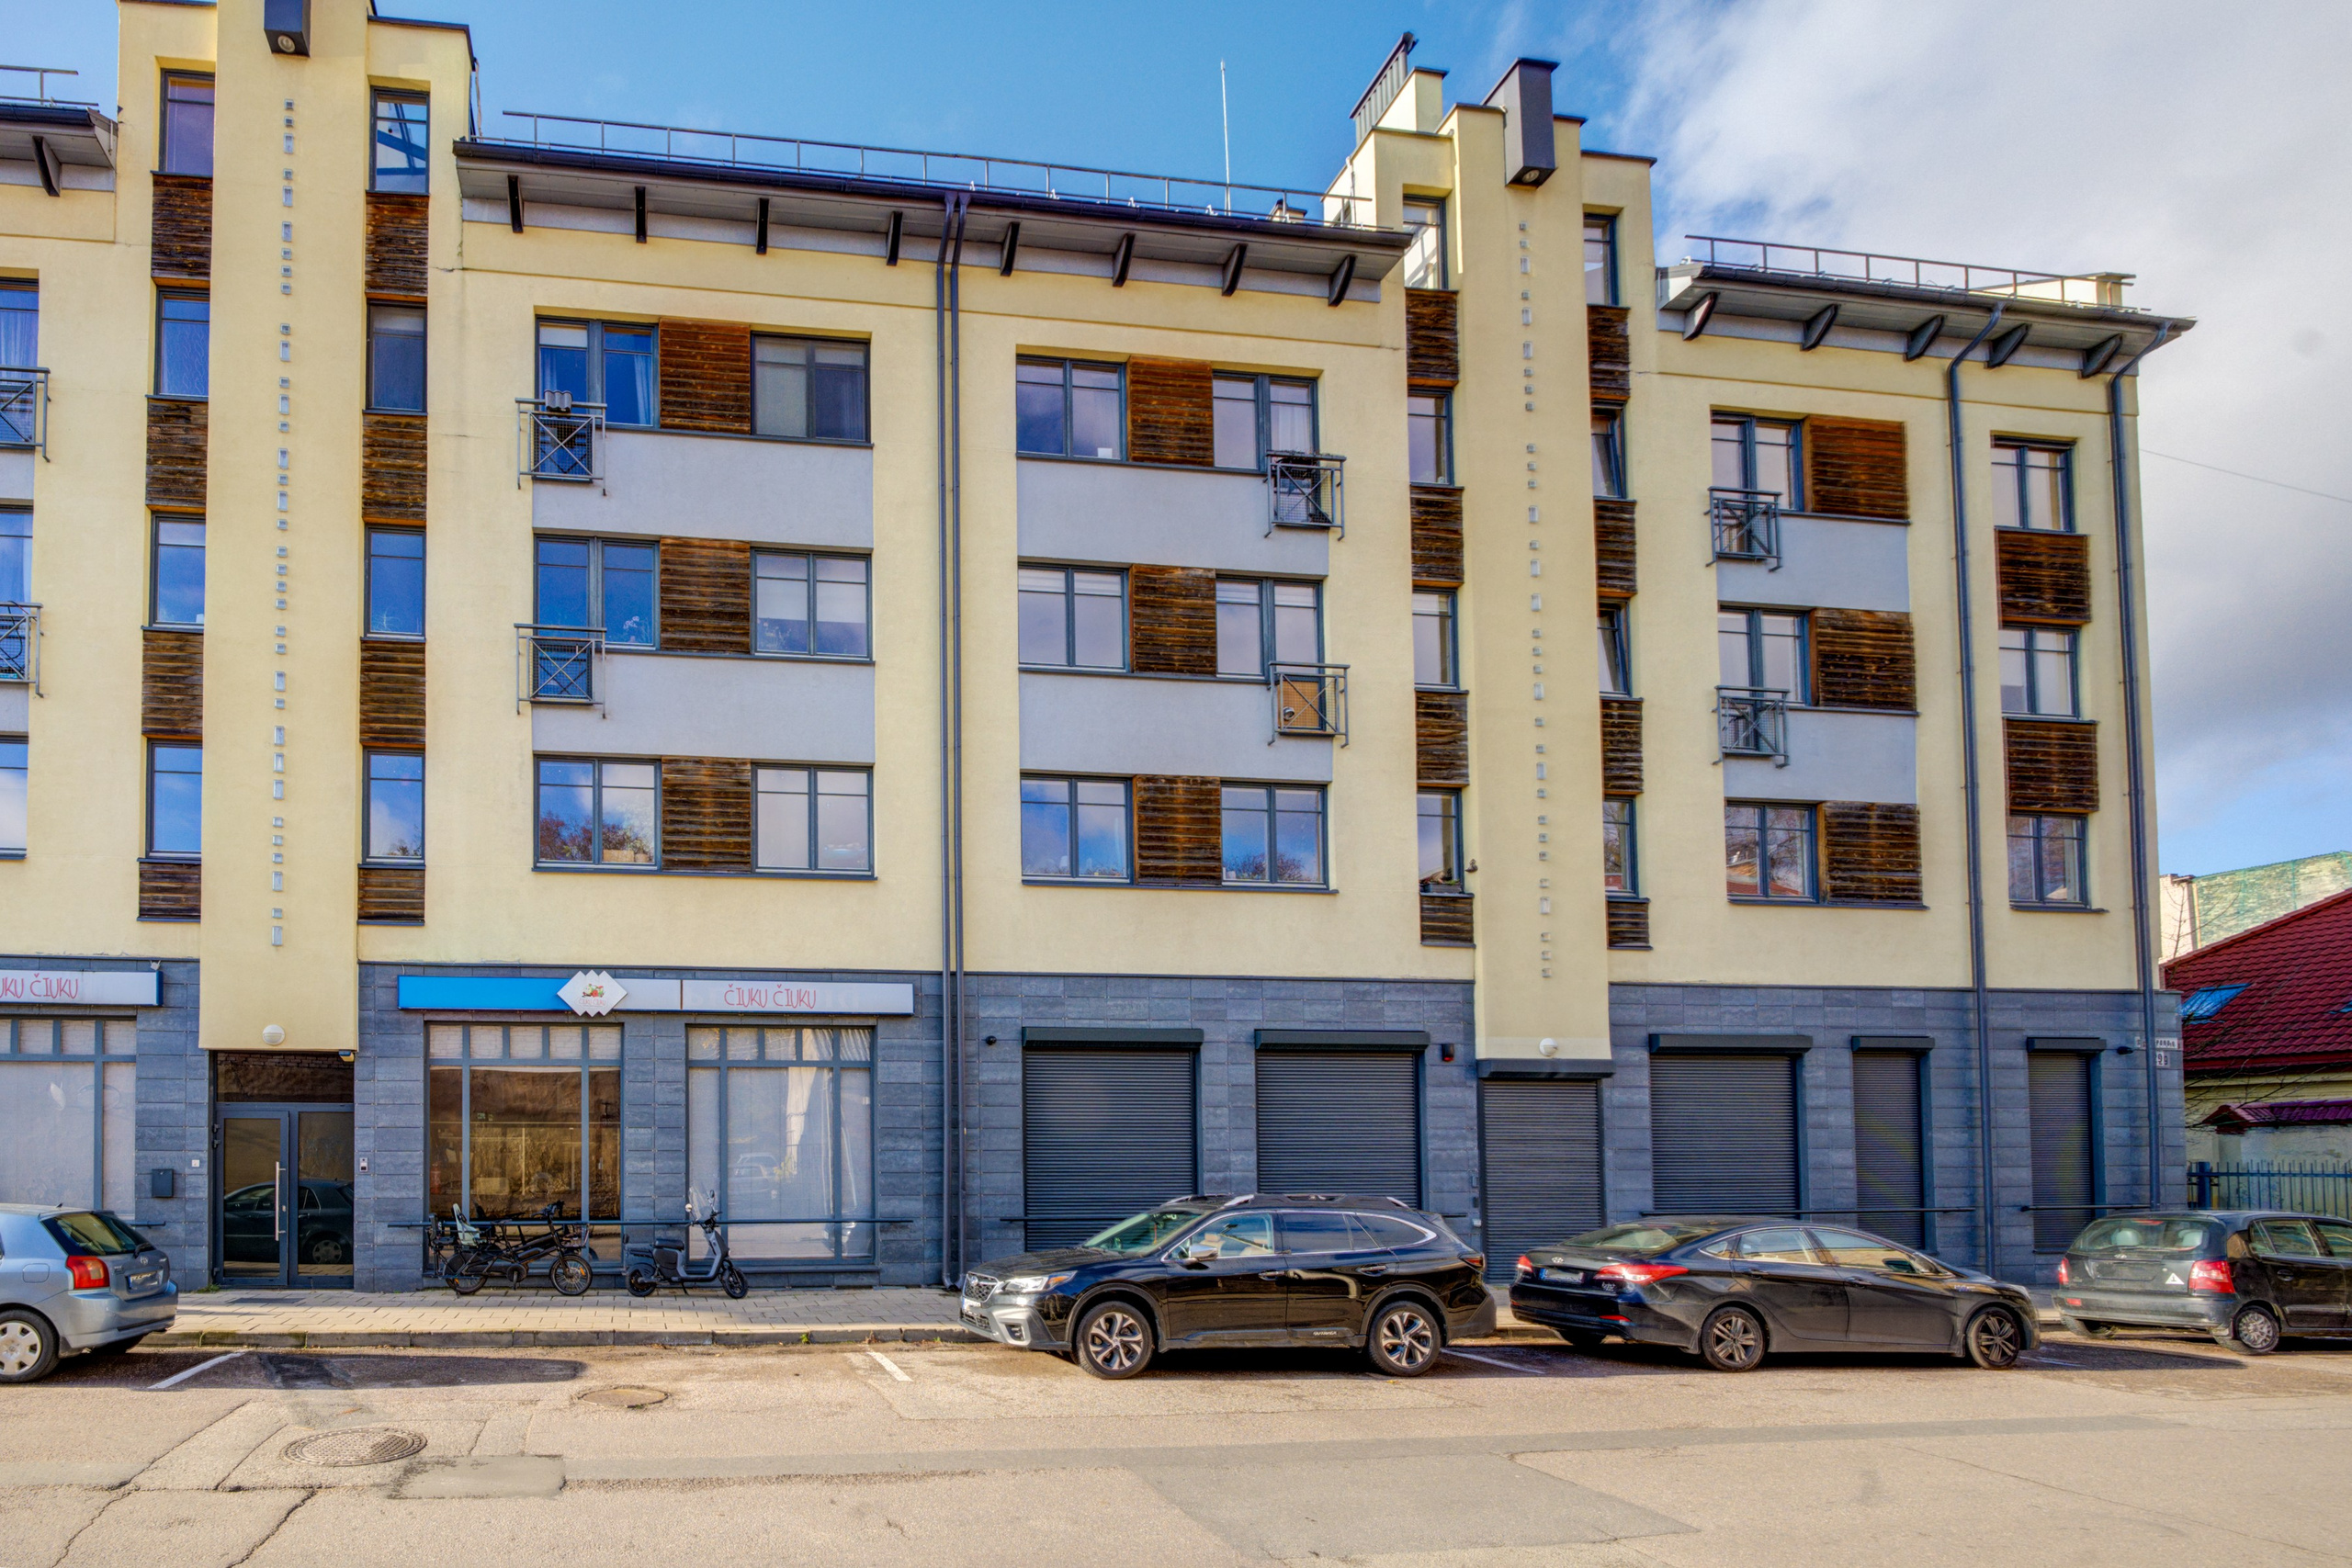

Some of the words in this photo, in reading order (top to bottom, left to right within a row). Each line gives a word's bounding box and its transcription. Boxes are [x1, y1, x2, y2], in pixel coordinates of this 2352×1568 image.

[29, 973, 79, 999] ČIUKU
[724, 983, 768, 1008] ČIUKU
[773, 984, 817, 1009] ČIUKU
